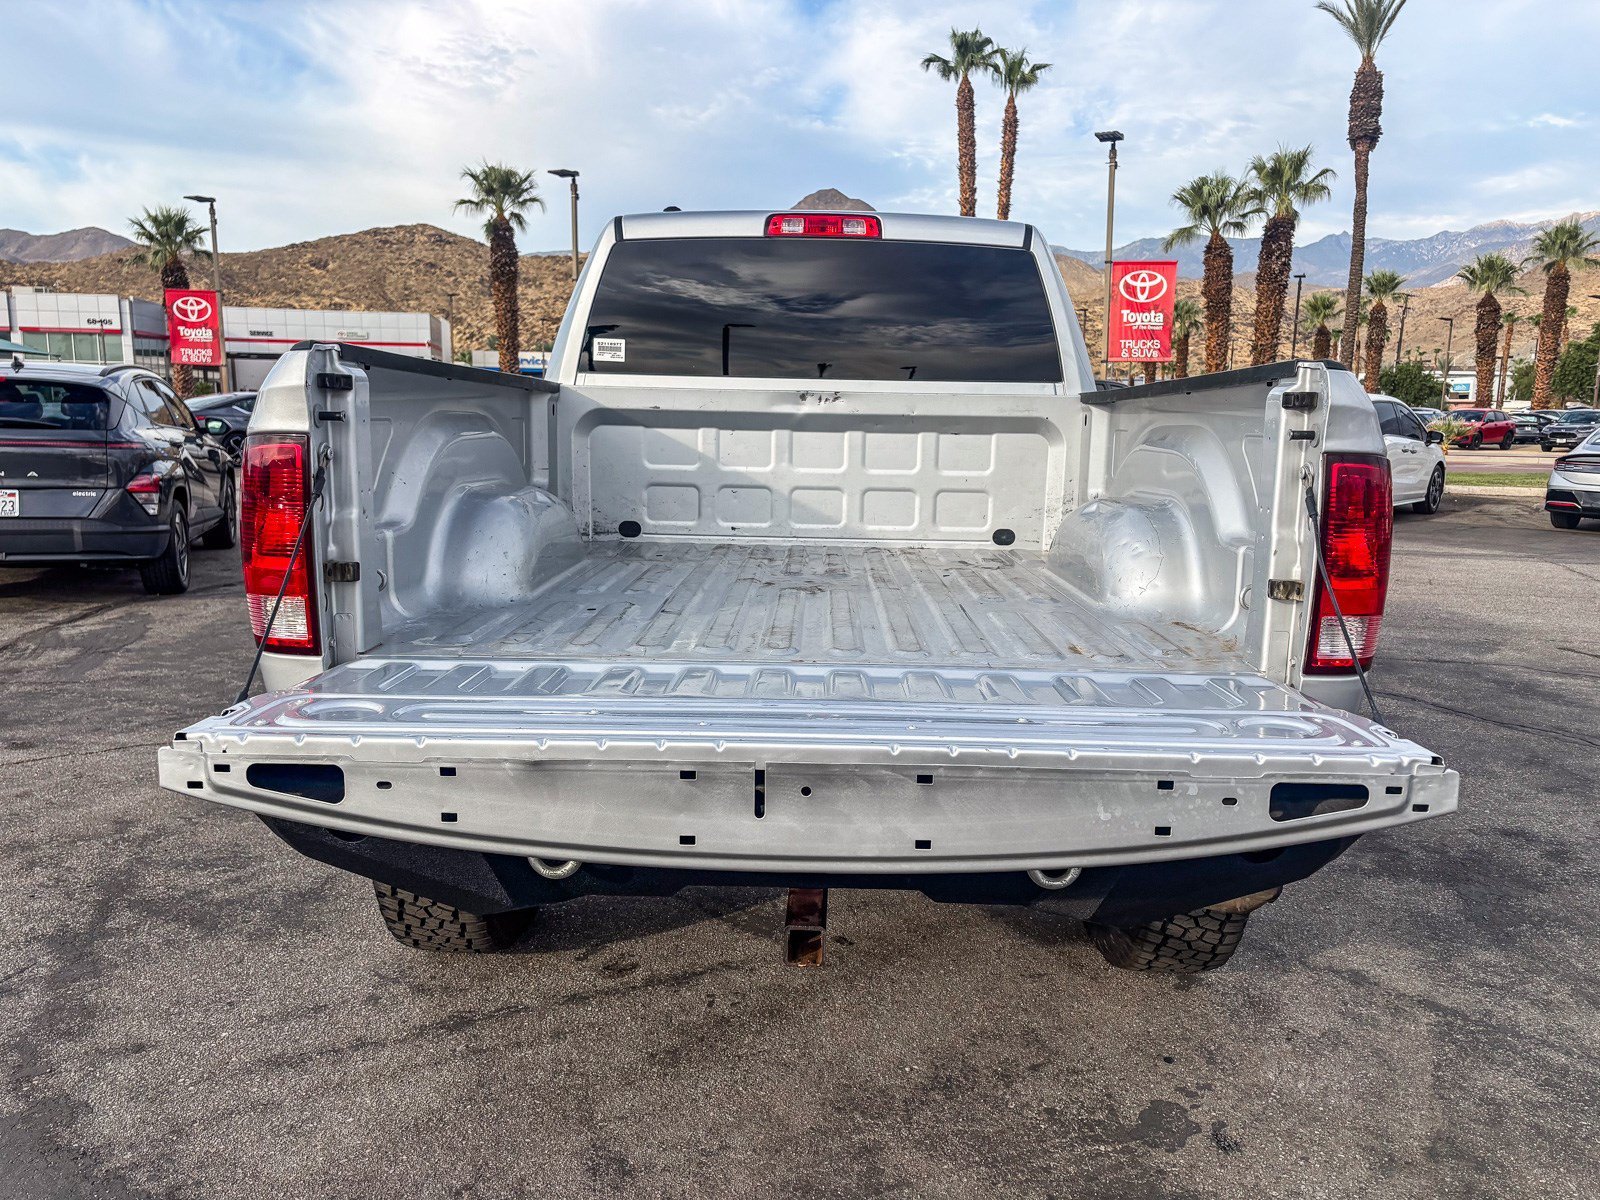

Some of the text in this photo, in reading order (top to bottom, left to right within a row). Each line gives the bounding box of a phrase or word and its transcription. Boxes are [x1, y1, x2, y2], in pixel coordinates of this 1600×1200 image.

[1120, 310, 1164, 325] Toyota
[177, 326, 213, 340] Toyota
[1119, 339, 1161, 349] TRUCKS
[180, 347, 213, 357] TRUCKS
[1121, 348, 1159, 358] & SUVs
[518, 355, 548, 365] rvice
